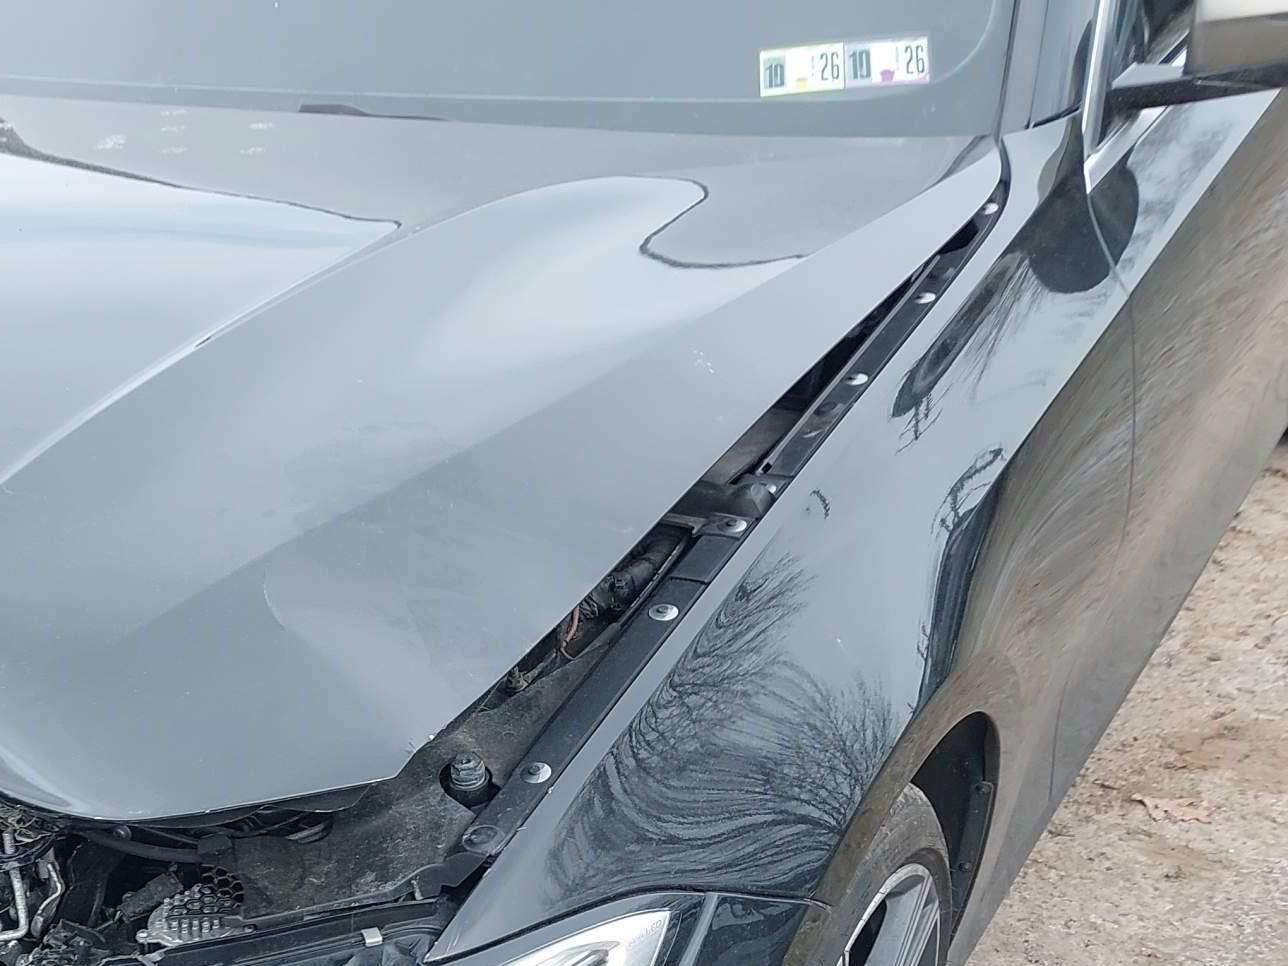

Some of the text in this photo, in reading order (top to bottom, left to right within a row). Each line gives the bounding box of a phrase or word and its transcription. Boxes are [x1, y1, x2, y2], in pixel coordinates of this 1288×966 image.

[765, 52, 840, 88] 10 26
[848, 45, 925, 80] 10 26
